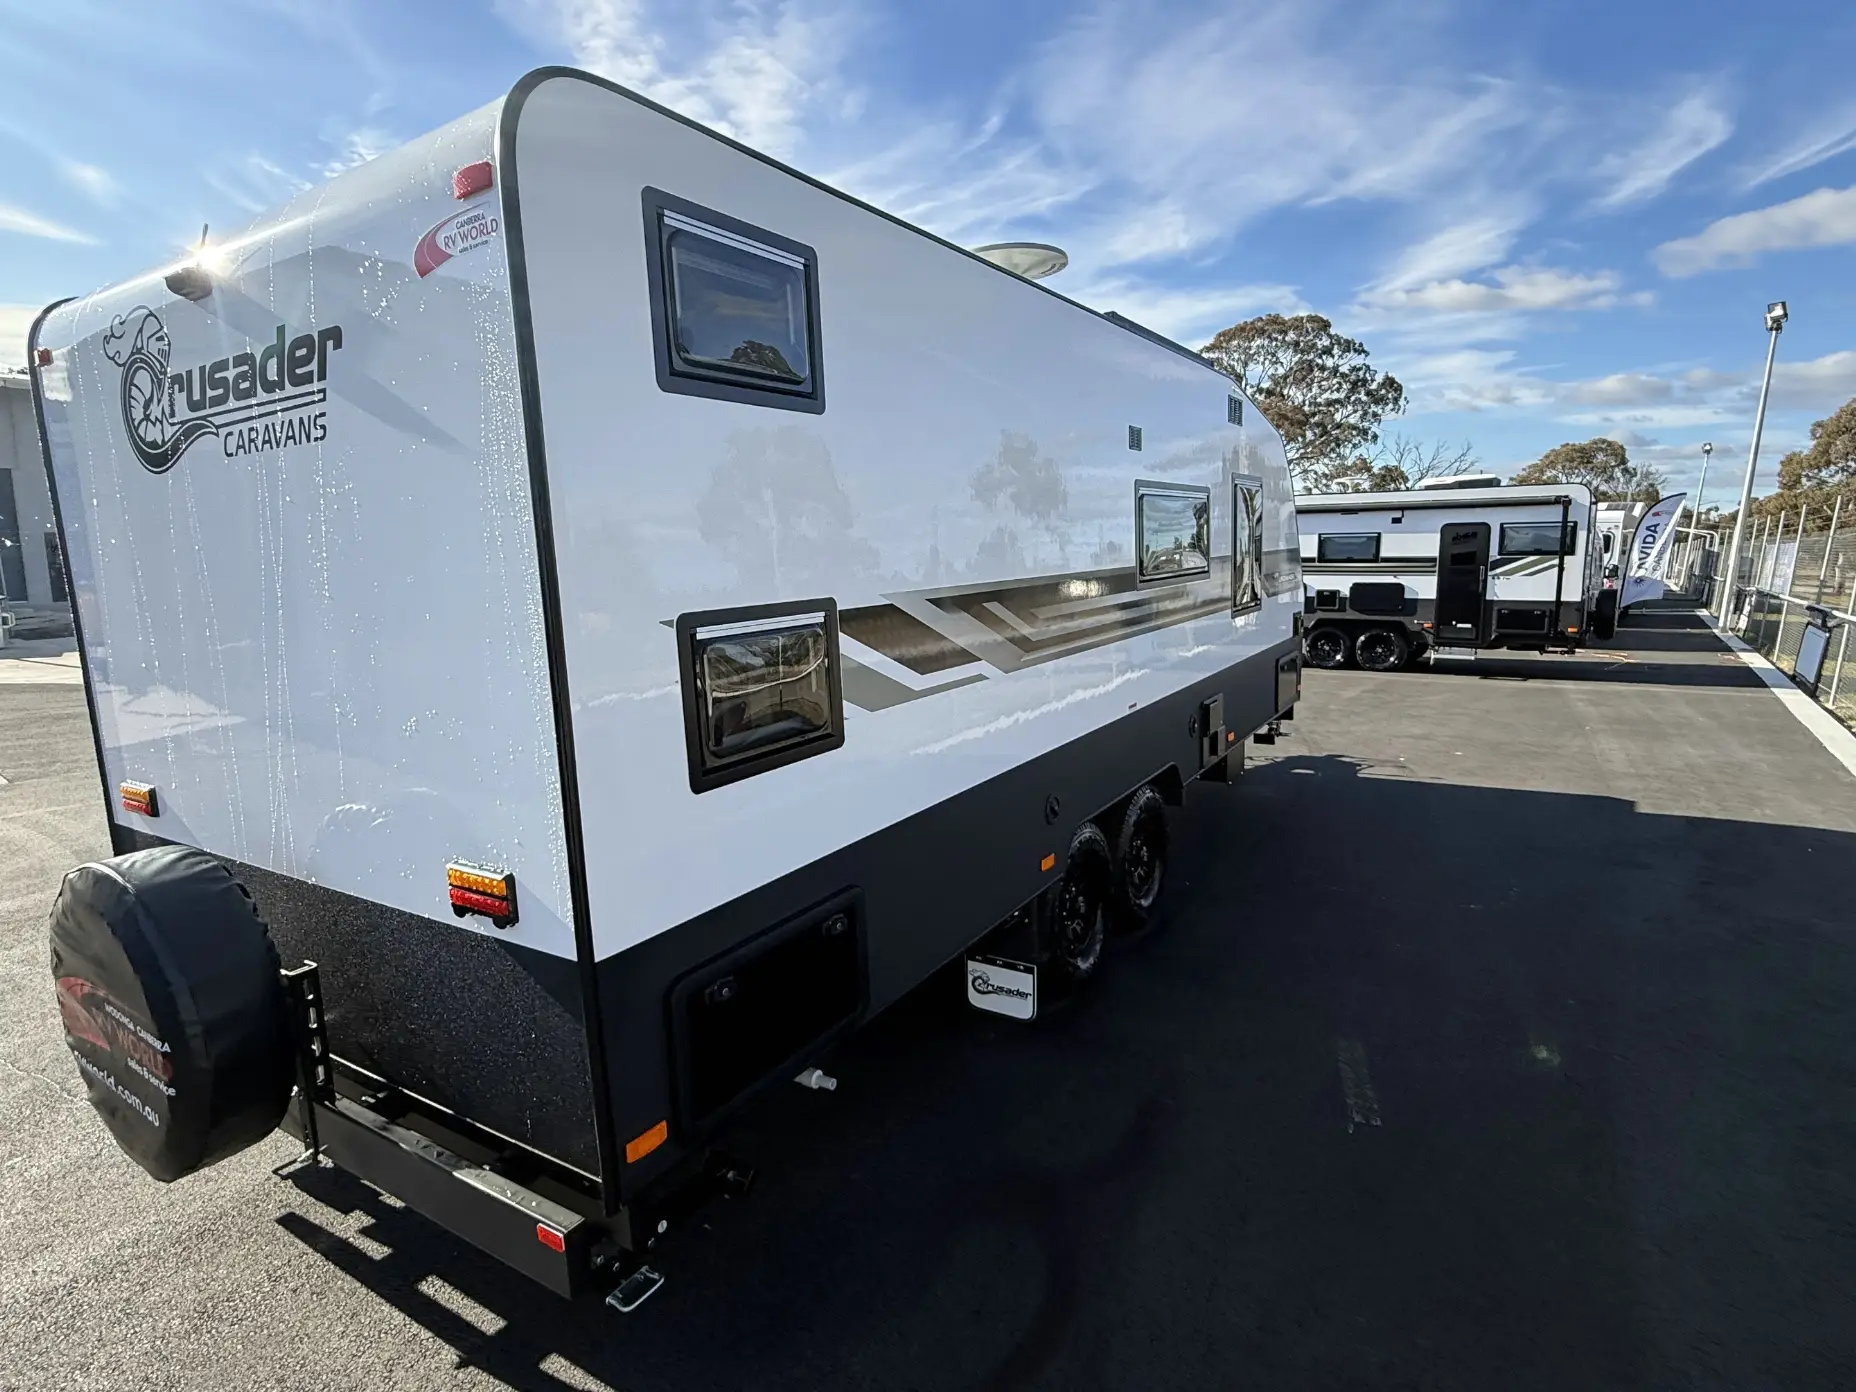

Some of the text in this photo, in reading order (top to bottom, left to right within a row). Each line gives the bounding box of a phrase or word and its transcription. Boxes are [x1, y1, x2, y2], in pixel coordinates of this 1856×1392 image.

[443, 217, 498, 250] RV WORLD
[455, 212, 485, 230] CANBERRA
[224, 412, 327, 457] CARAVANS
